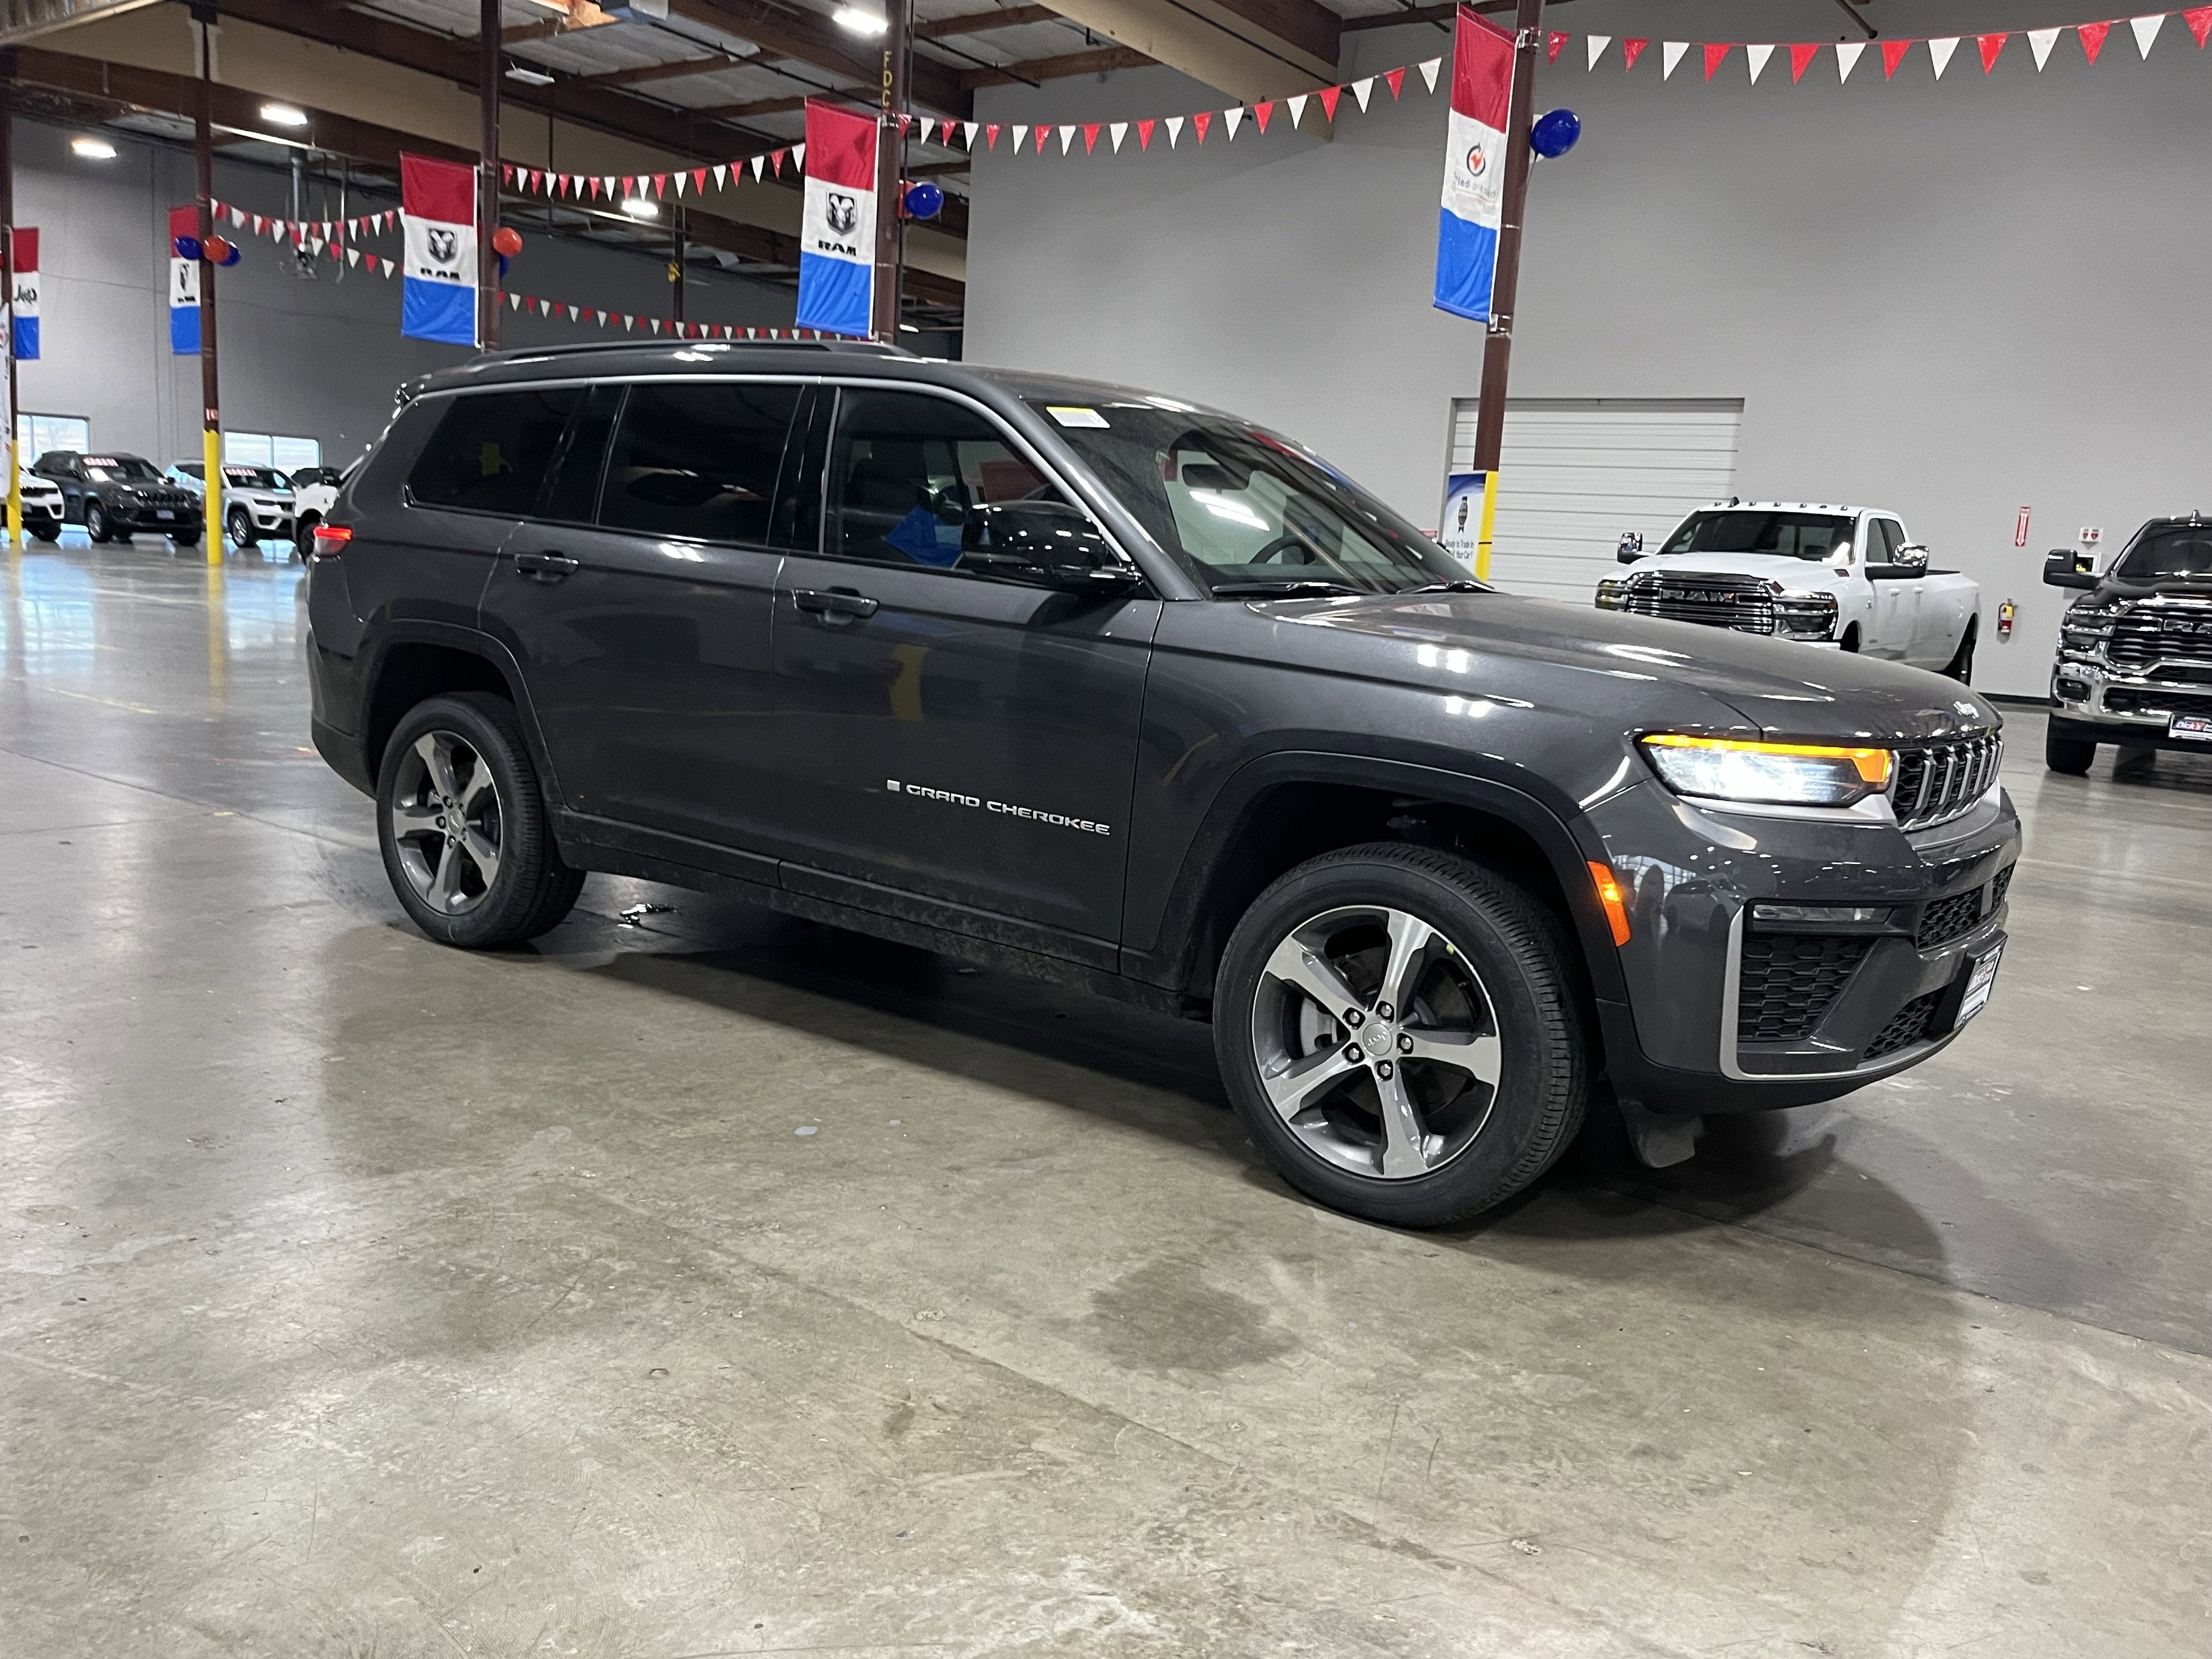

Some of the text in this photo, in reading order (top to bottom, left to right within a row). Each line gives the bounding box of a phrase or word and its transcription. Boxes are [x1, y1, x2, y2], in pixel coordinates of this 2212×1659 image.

[818, 239, 856, 257] RAM
[1662, 589, 1734, 603] RAM
[906, 784, 1110, 836] GRAND CHEROKEE
